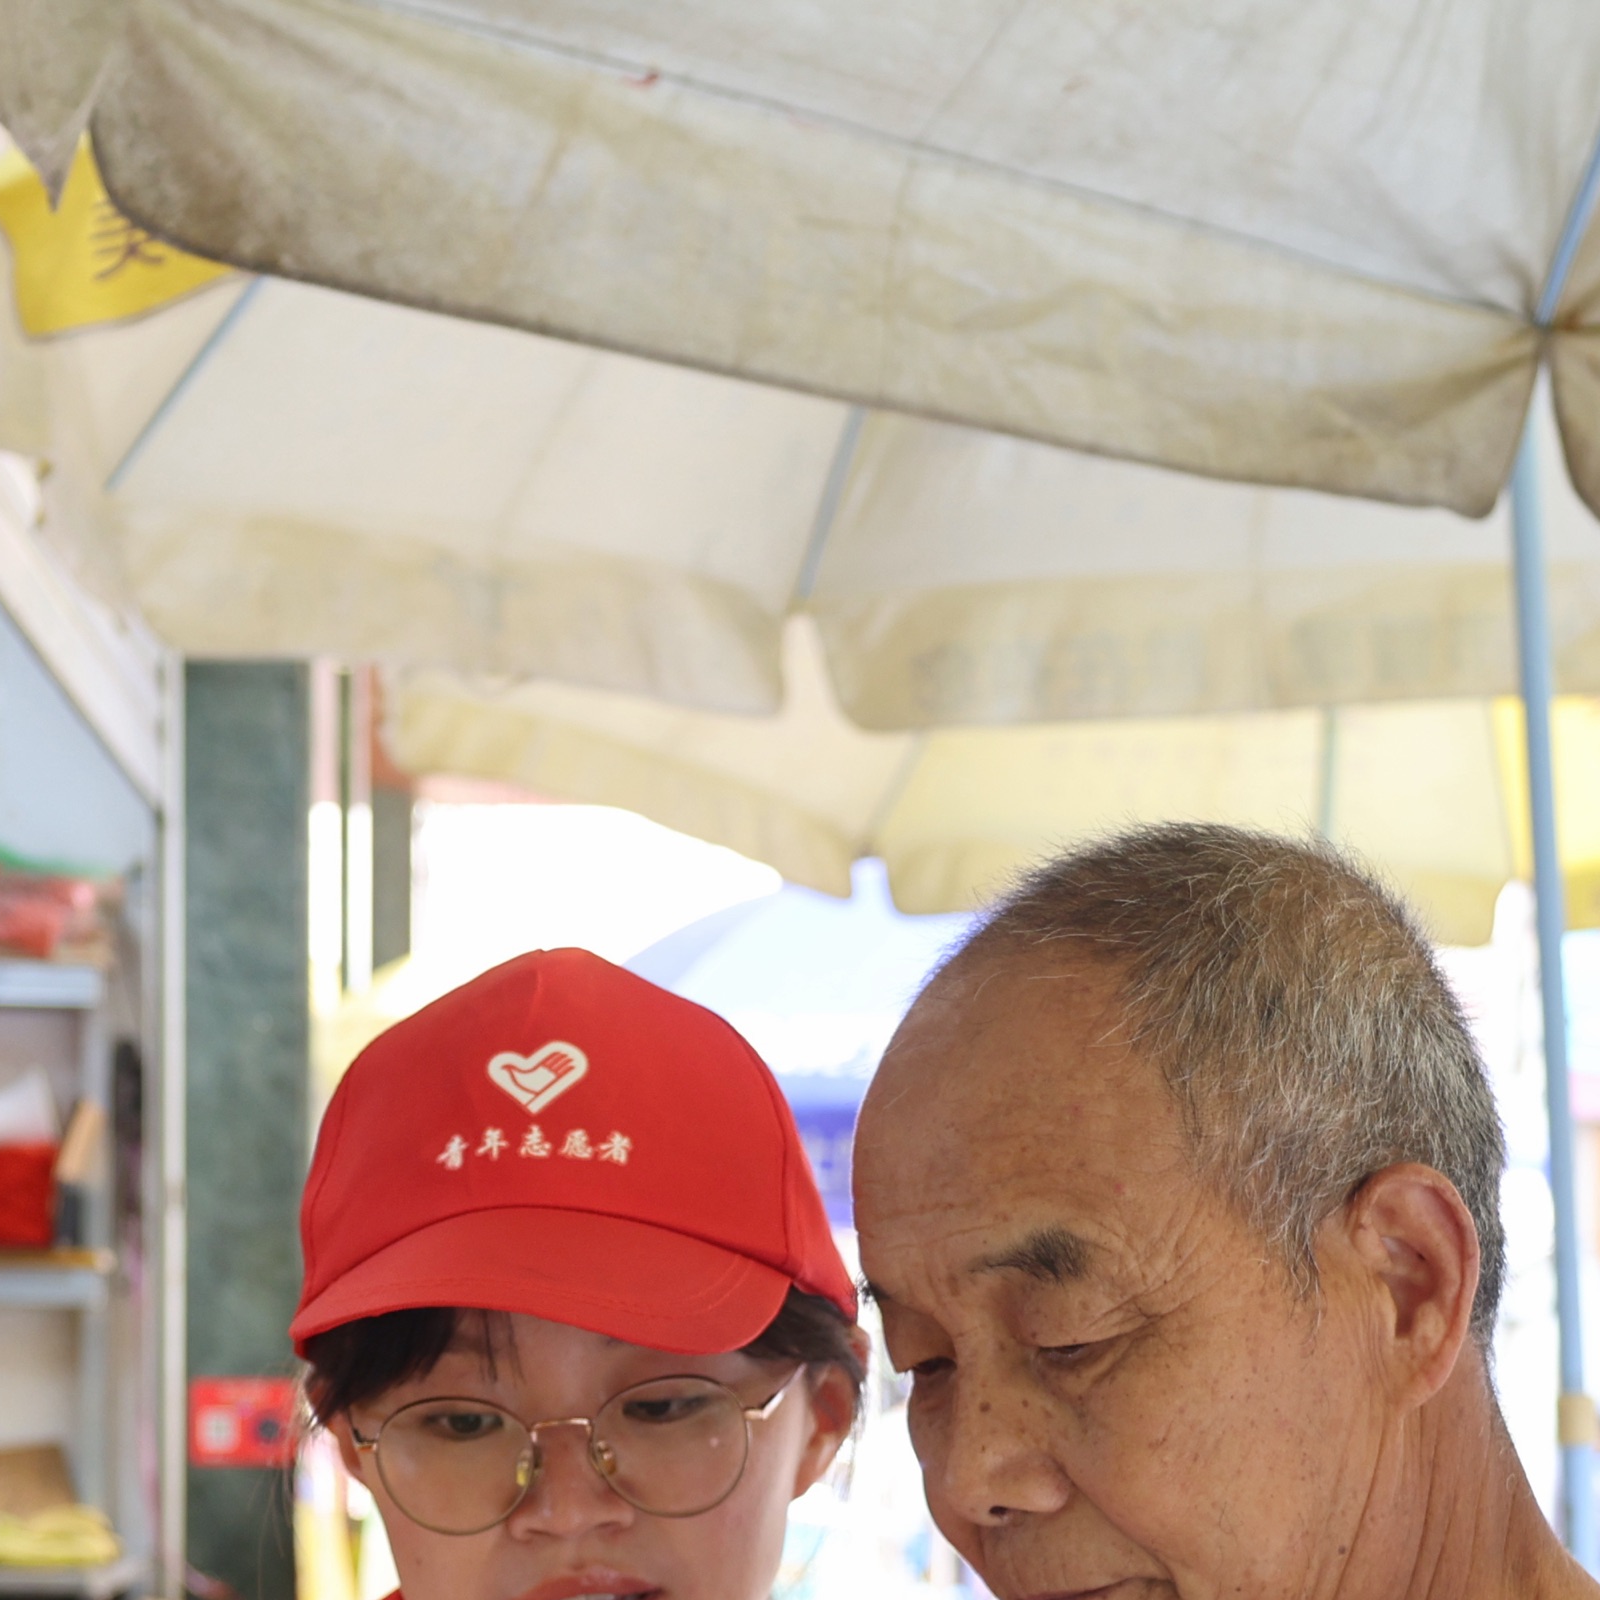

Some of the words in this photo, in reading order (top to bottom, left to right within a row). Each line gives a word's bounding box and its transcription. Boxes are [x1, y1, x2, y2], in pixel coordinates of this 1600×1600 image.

[436, 1123, 632, 1170] 青年志愿者
